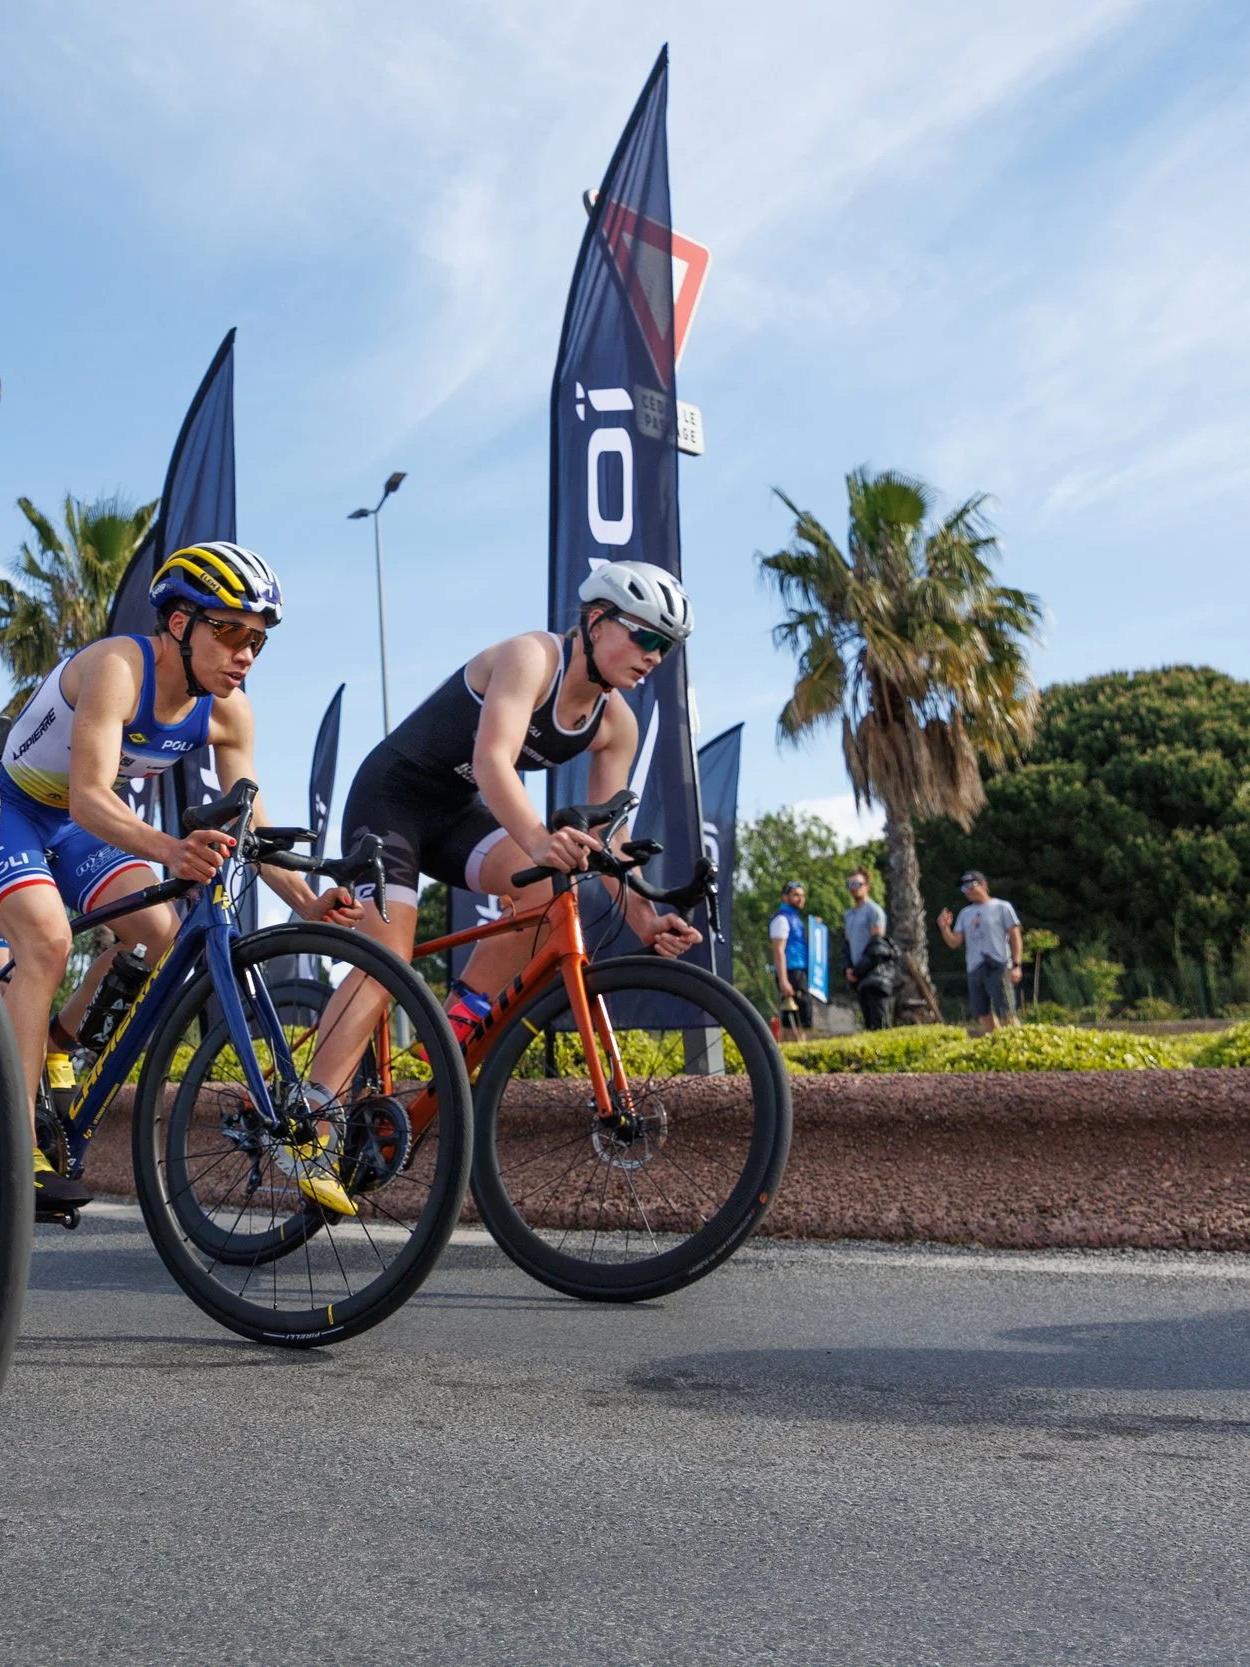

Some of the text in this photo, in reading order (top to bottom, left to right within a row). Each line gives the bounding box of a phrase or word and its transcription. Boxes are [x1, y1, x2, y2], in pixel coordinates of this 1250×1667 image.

[12, 706, 56, 761] LAPIERRE
[161, 740, 194, 752] POLI
[285, 1331, 321, 1340] PIRELLI
